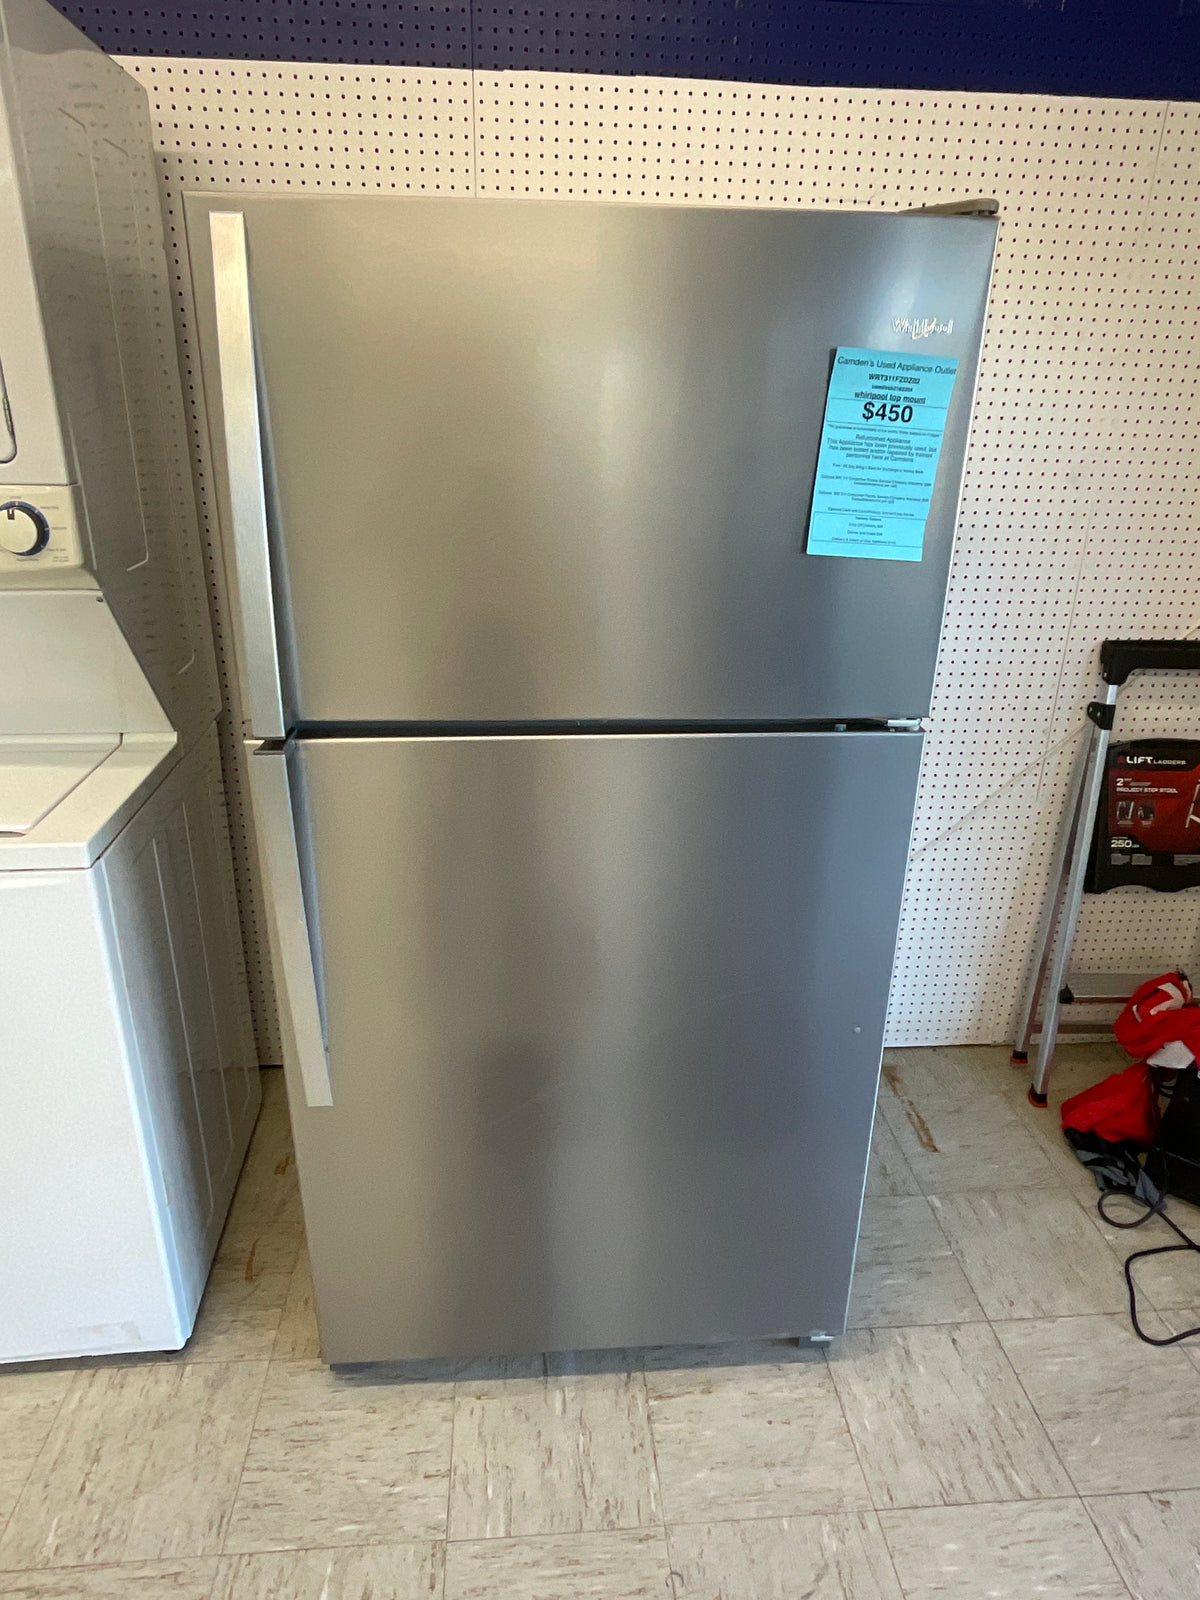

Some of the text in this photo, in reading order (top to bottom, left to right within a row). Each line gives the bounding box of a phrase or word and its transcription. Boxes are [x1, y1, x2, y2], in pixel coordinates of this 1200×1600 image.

[837, 356, 957, 376] Camden's Used Appliance Outlet
[854, 391, 926, 405] whirlpool top mount
[862, 401, 914, 423] $450
[1126, 756, 1154, 764] LIFT
[1116, 778, 1124, 786] 2
[1111, 840, 1132, 848] 250
